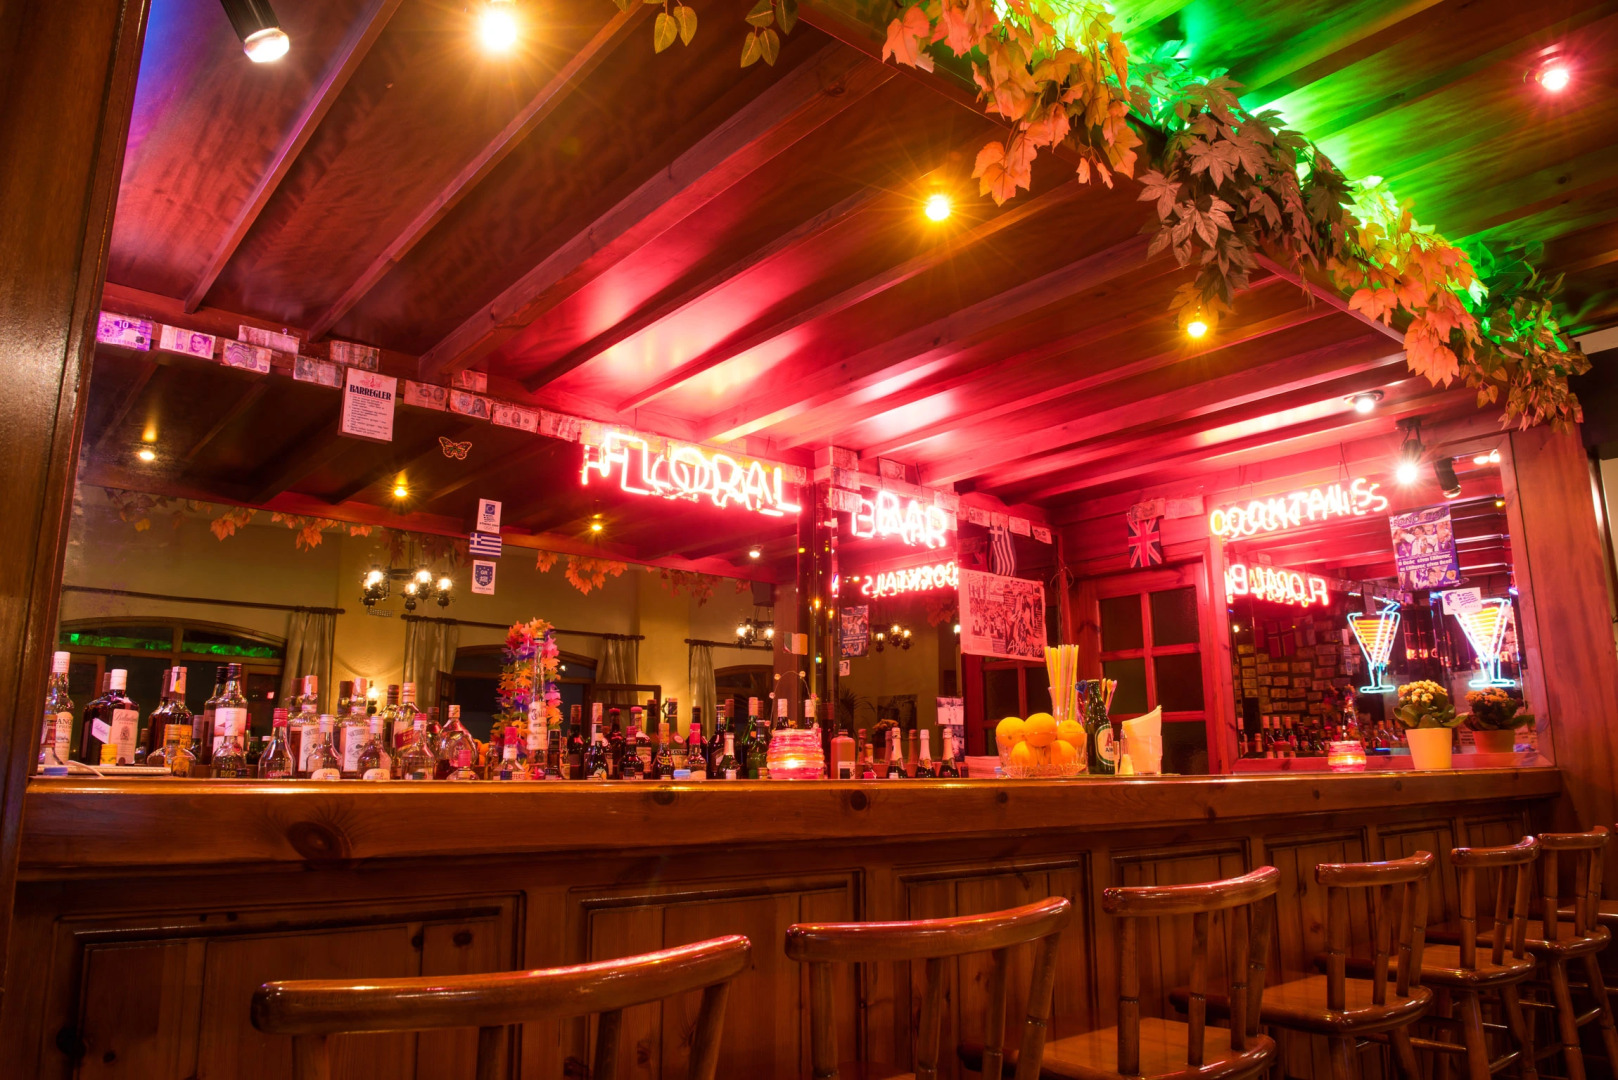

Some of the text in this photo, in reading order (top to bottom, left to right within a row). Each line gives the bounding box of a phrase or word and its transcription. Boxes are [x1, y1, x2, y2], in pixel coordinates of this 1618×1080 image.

[119, 320, 130, 329] 10
[349, 383, 391, 401] BARREGLER
[602, 430, 803, 514] FLORAL
